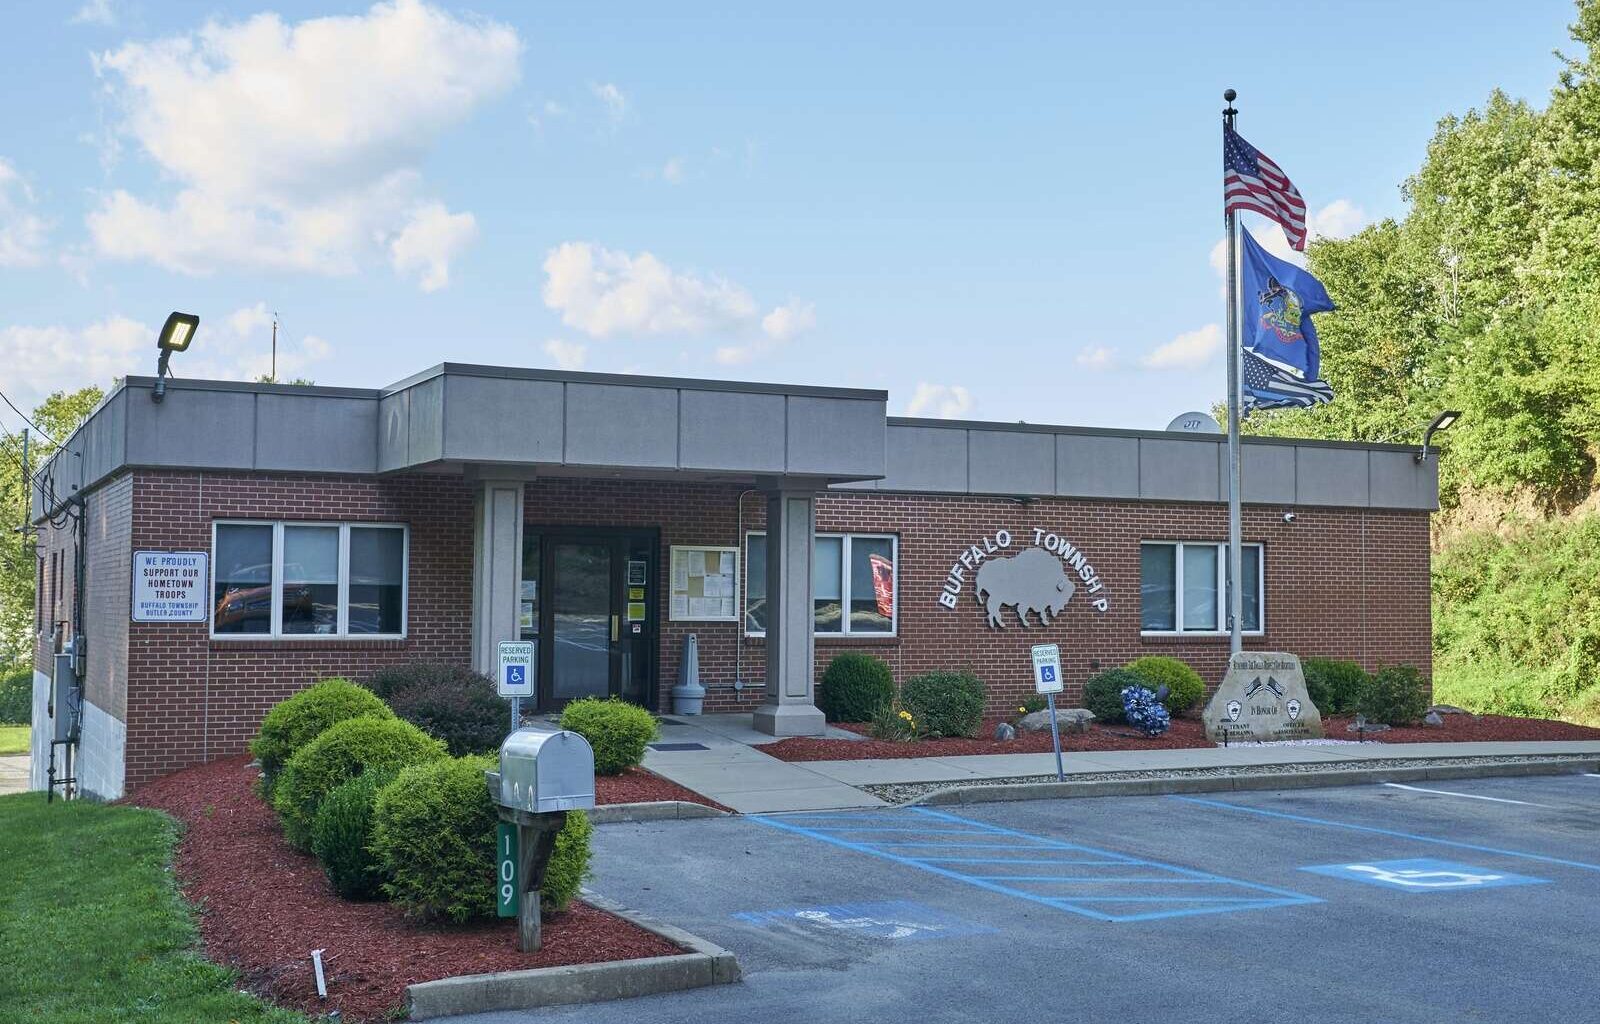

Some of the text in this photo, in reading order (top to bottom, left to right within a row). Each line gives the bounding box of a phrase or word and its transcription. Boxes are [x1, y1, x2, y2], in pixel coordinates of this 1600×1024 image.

[145, 556, 197, 566] WE PROUDLY
[143, 568, 199, 578] SUPPORT OUR
[939, 528, 1108, 612] BUFFALO TOWNSHP
[148, 579, 194, 588] HOMETOWN
[155, 590, 186, 599] TROOPS
[145, 609, 193, 617] BUTLER COUNTY
[500, 646, 531, 655] RESERVED
[502, 655, 529, 664] PARKING
[501, 834, 514, 906] 109
